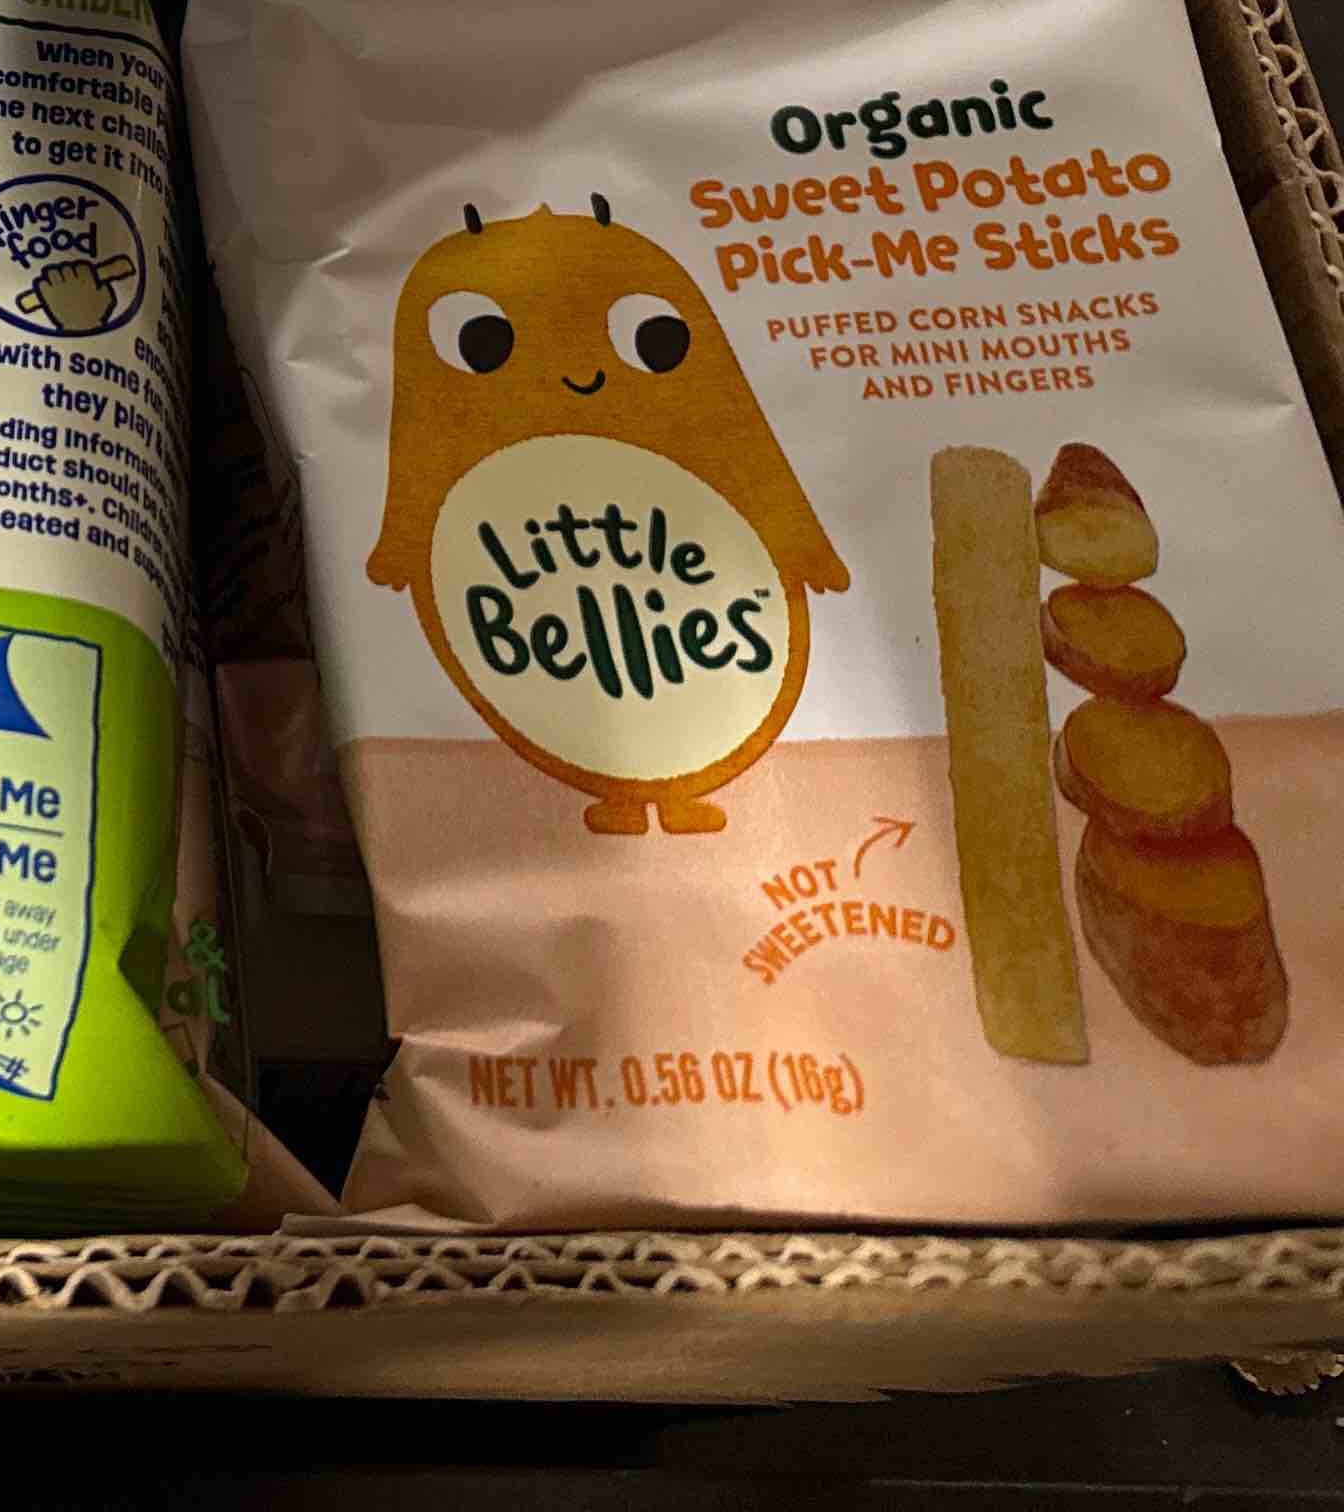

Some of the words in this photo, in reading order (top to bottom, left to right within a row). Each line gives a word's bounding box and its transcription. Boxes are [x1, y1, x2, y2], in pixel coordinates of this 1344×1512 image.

[36, 41, 113, 69] When
[770, 78, 1053, 158] Organic
[688, 172, 905, 232] Sweet
[917, 151, 1171, 211] Potato
[7, 223, 96, 267] food
[716, 226, 958, 292] Pick-Me
[975, 212, 1180, 274] Sticks
[765, 308, 898, 343] PUFFED
[908, 298, 1009, 334] CORN
[1021, 292, 1159, 326] SNACKS
[808, 343, 880, 371] FOR
[891, 338, 970, 366] MINI
[982, 326, 1132, 361] MOUTHS
[861, 373, 933, 401] AND
[945, 364, 1095, 395] FINGERS
[478, 503, 714, 592] Little
[0, 777, 60, 819] Me
[760, 858, 841, 909] NOT
[742, 900, 956, 985] SWEETENED
[469, 1055, 541, 1110] NET
[550, 1055, 616, 1110] WT.
[622, 1057, 702, 1105] 0.56
[713, 1055, 760, 1105] OZ
[767, 1052, 866, 1112] (16g)
